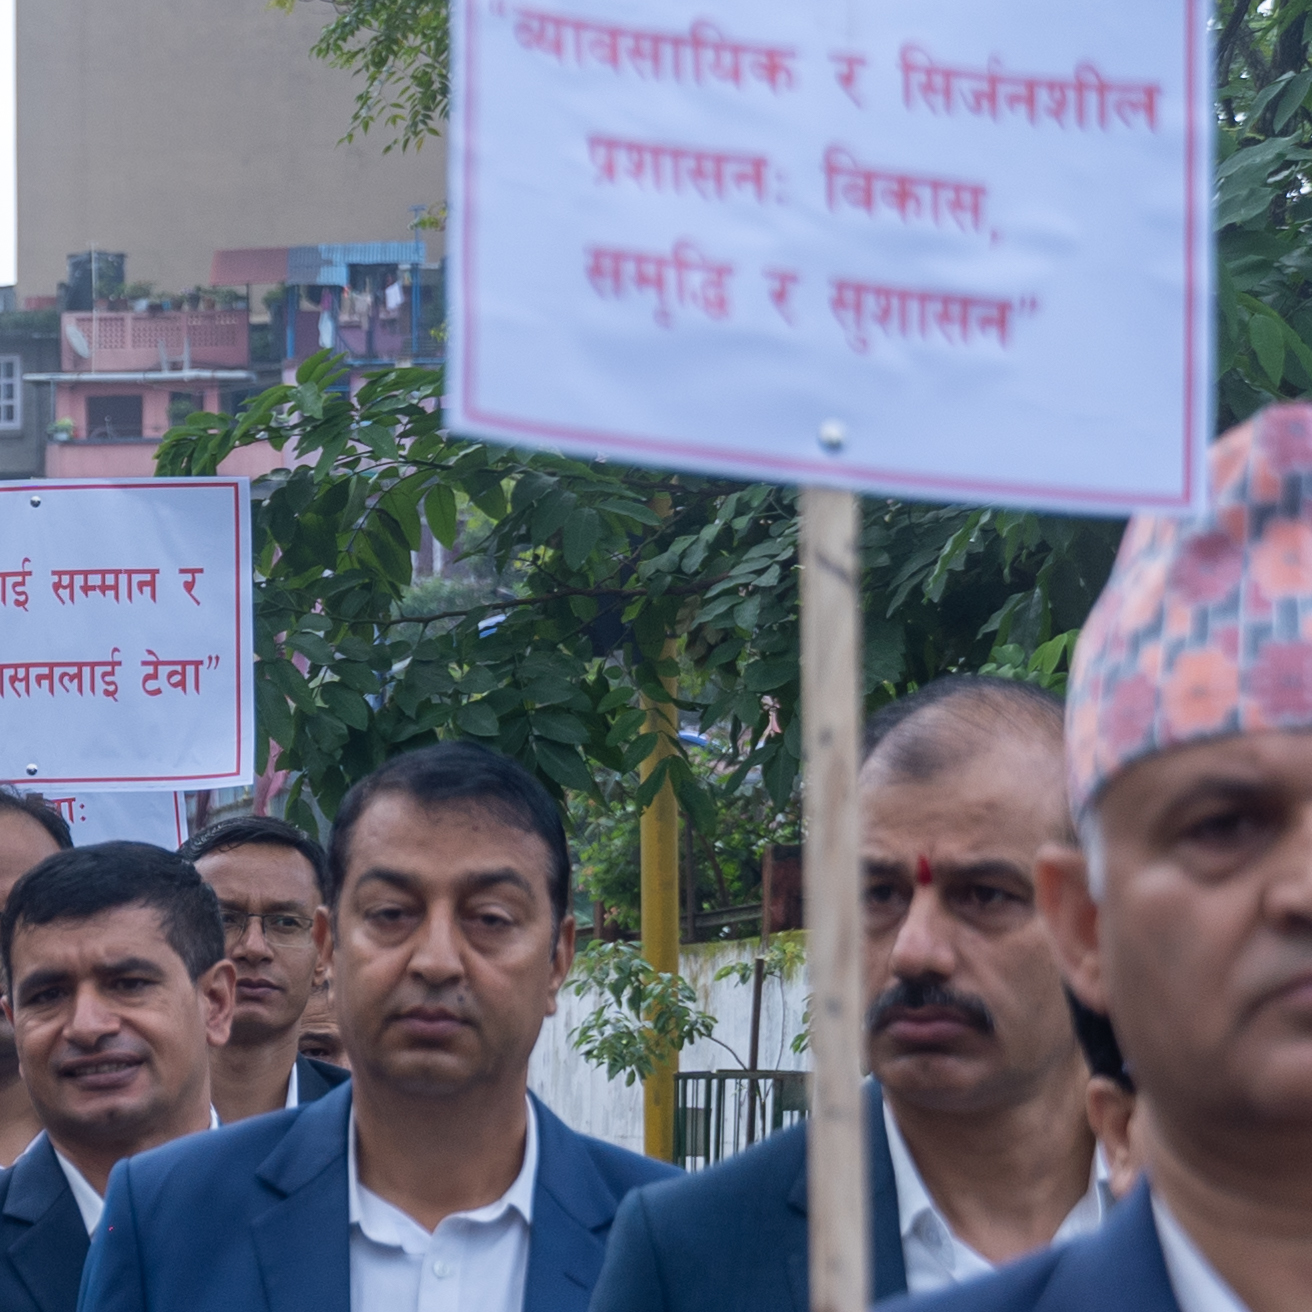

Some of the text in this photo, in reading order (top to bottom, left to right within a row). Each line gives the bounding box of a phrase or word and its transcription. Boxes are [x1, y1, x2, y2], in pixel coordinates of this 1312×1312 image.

[829, 53, 867, 107] र
[899, 44, 1162, 132] सिर्जनशील
[823, 144, 1004, 249] विकास,
[586, 239, 1040, 354] समृद्धि र सुशासन”
[51, 568, 159, 605] सम्मान
[179, 568, 204, 606] र
[141, 649, 221, 697] टेवा”
